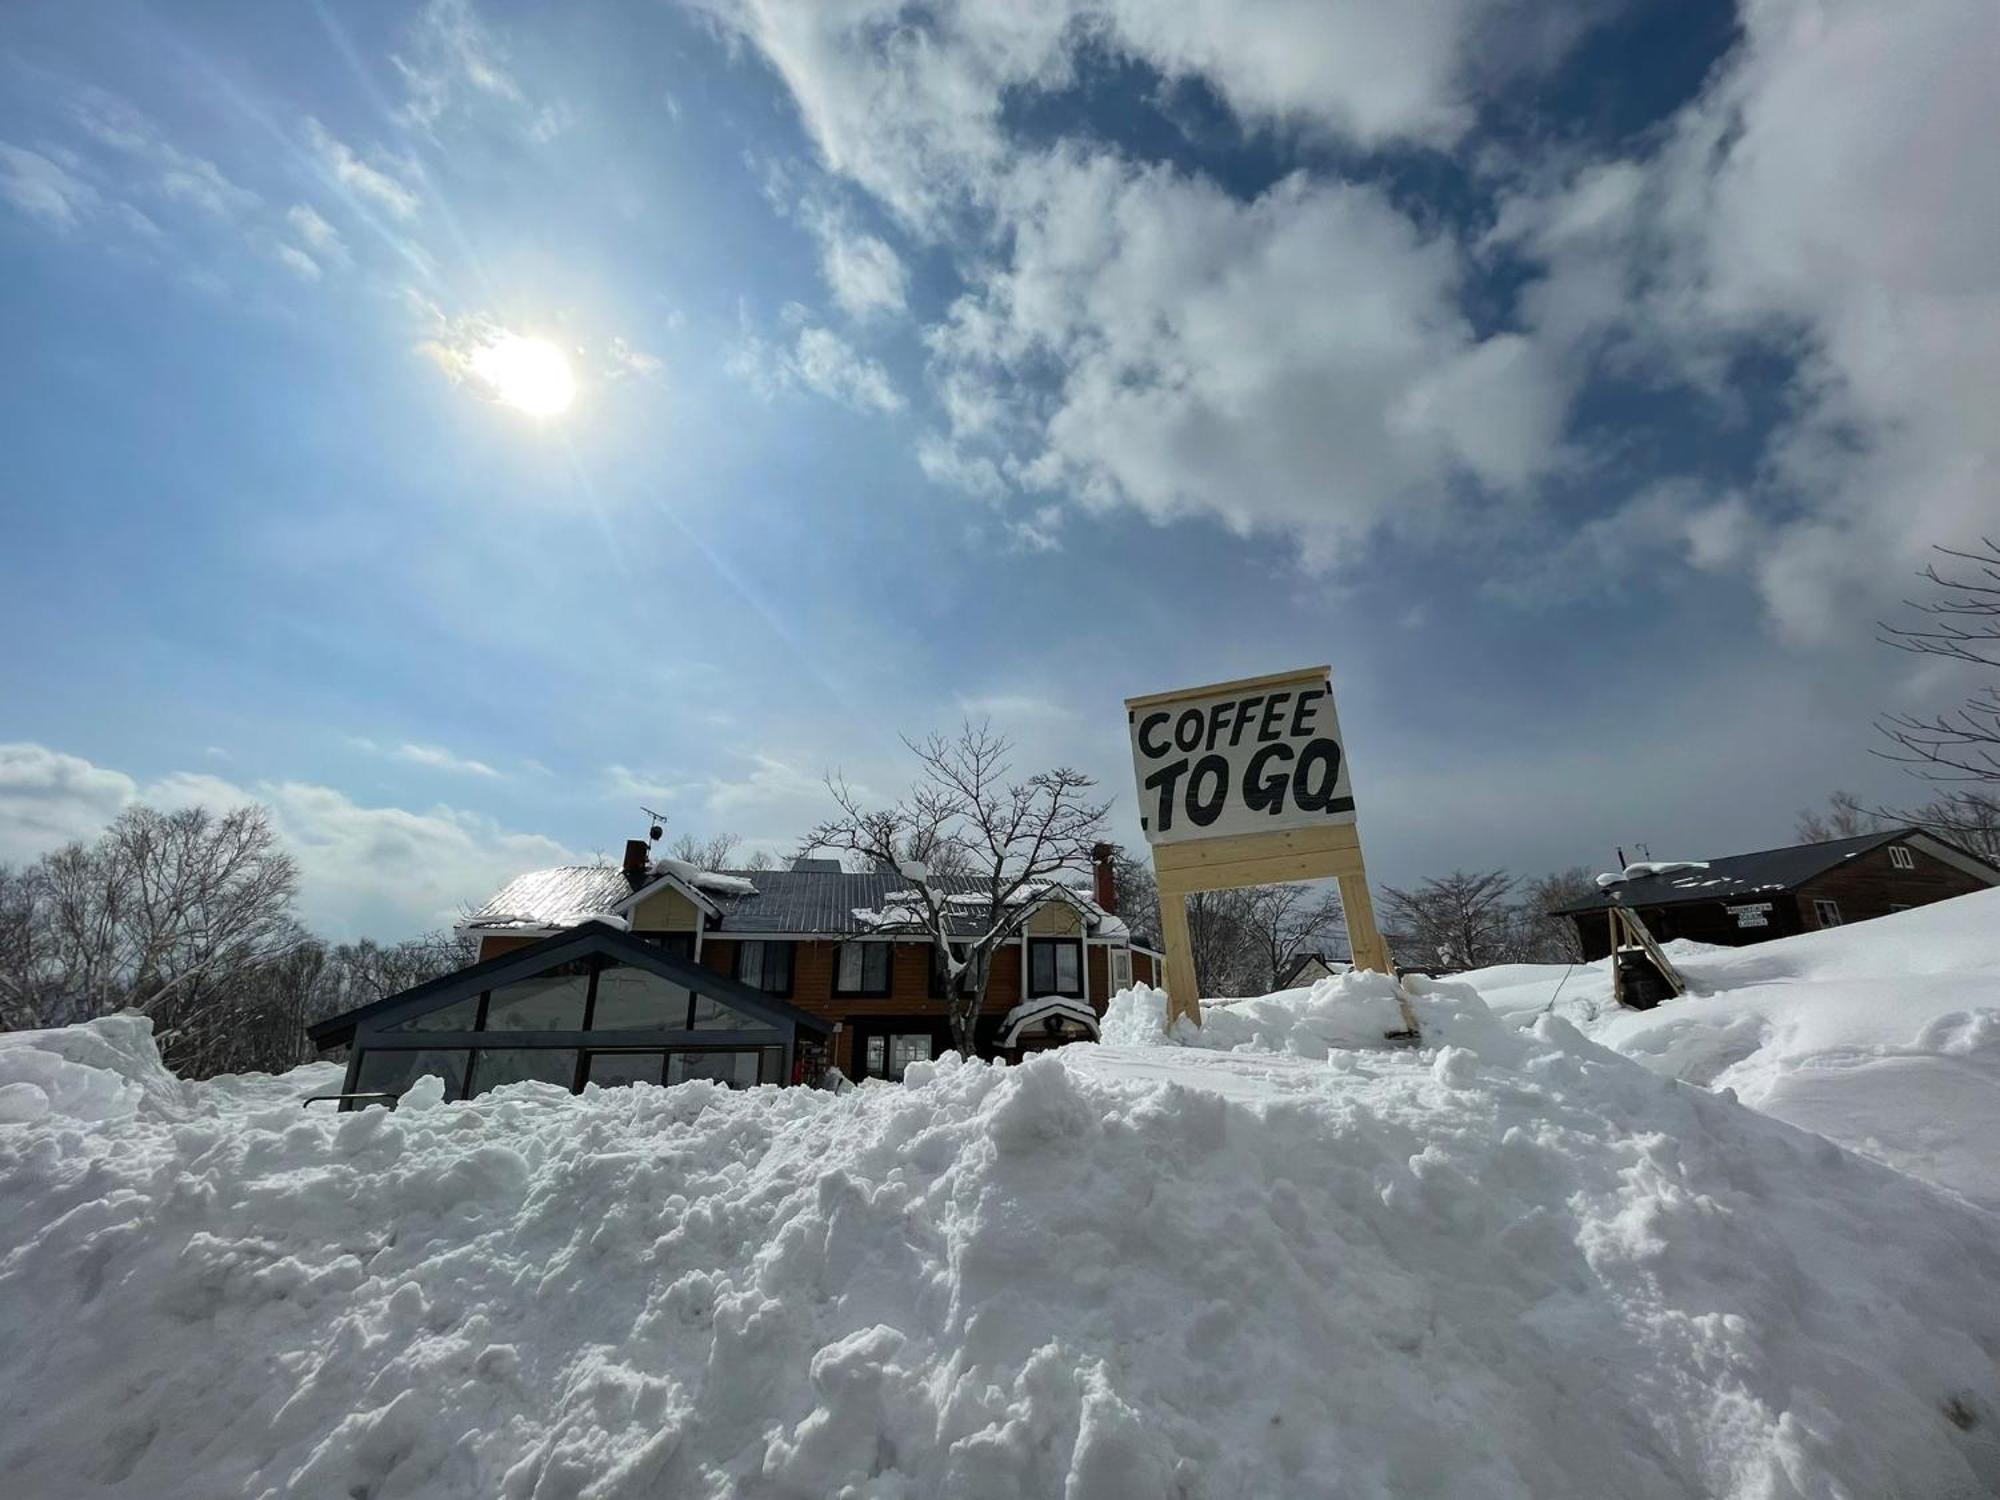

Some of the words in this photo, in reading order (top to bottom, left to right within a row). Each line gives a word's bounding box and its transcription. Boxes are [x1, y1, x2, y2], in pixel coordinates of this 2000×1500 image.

[1138, 690, 1325, 758] COFFEE
[1145, 754, 1229, 832] TO
[1242, 738, 1341, 815] GO
